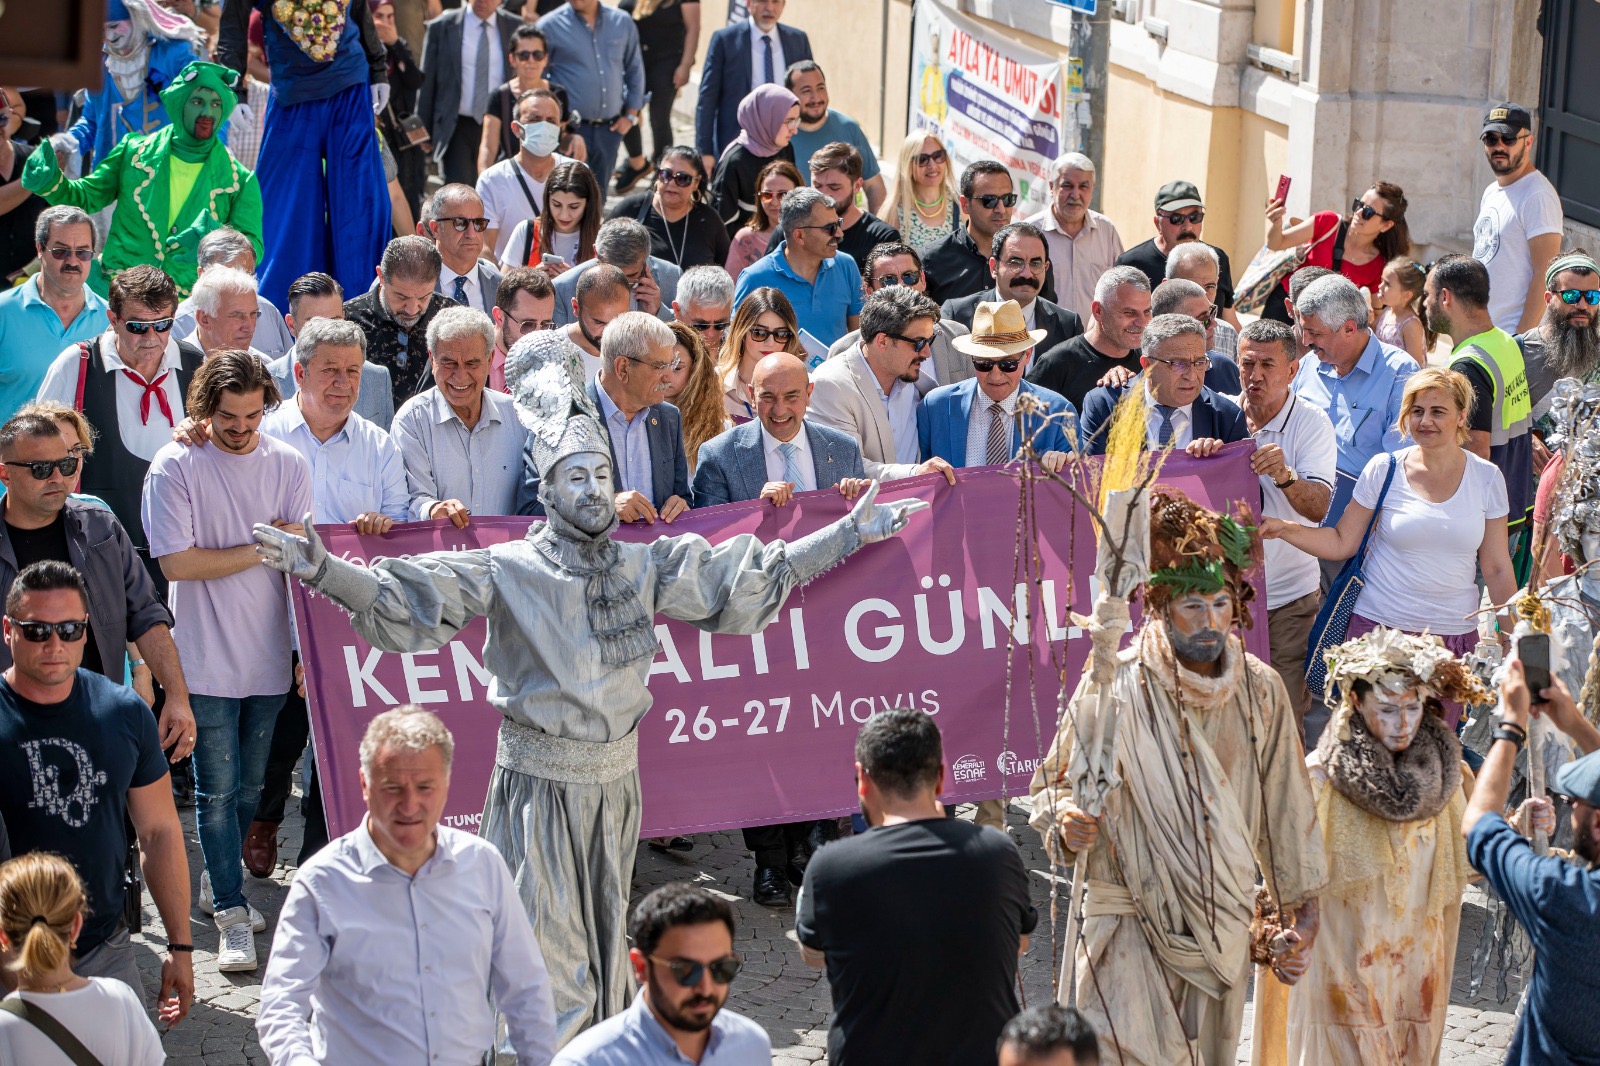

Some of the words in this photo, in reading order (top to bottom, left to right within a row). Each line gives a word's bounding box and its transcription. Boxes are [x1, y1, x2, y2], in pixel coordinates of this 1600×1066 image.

[948, 28, 999, 88] AYLA'YA
[1004, 56, 1038, 107] UMUT
[665, 696, 791, 744] 26-27
[954, 767, 986, 781] ESNAF
